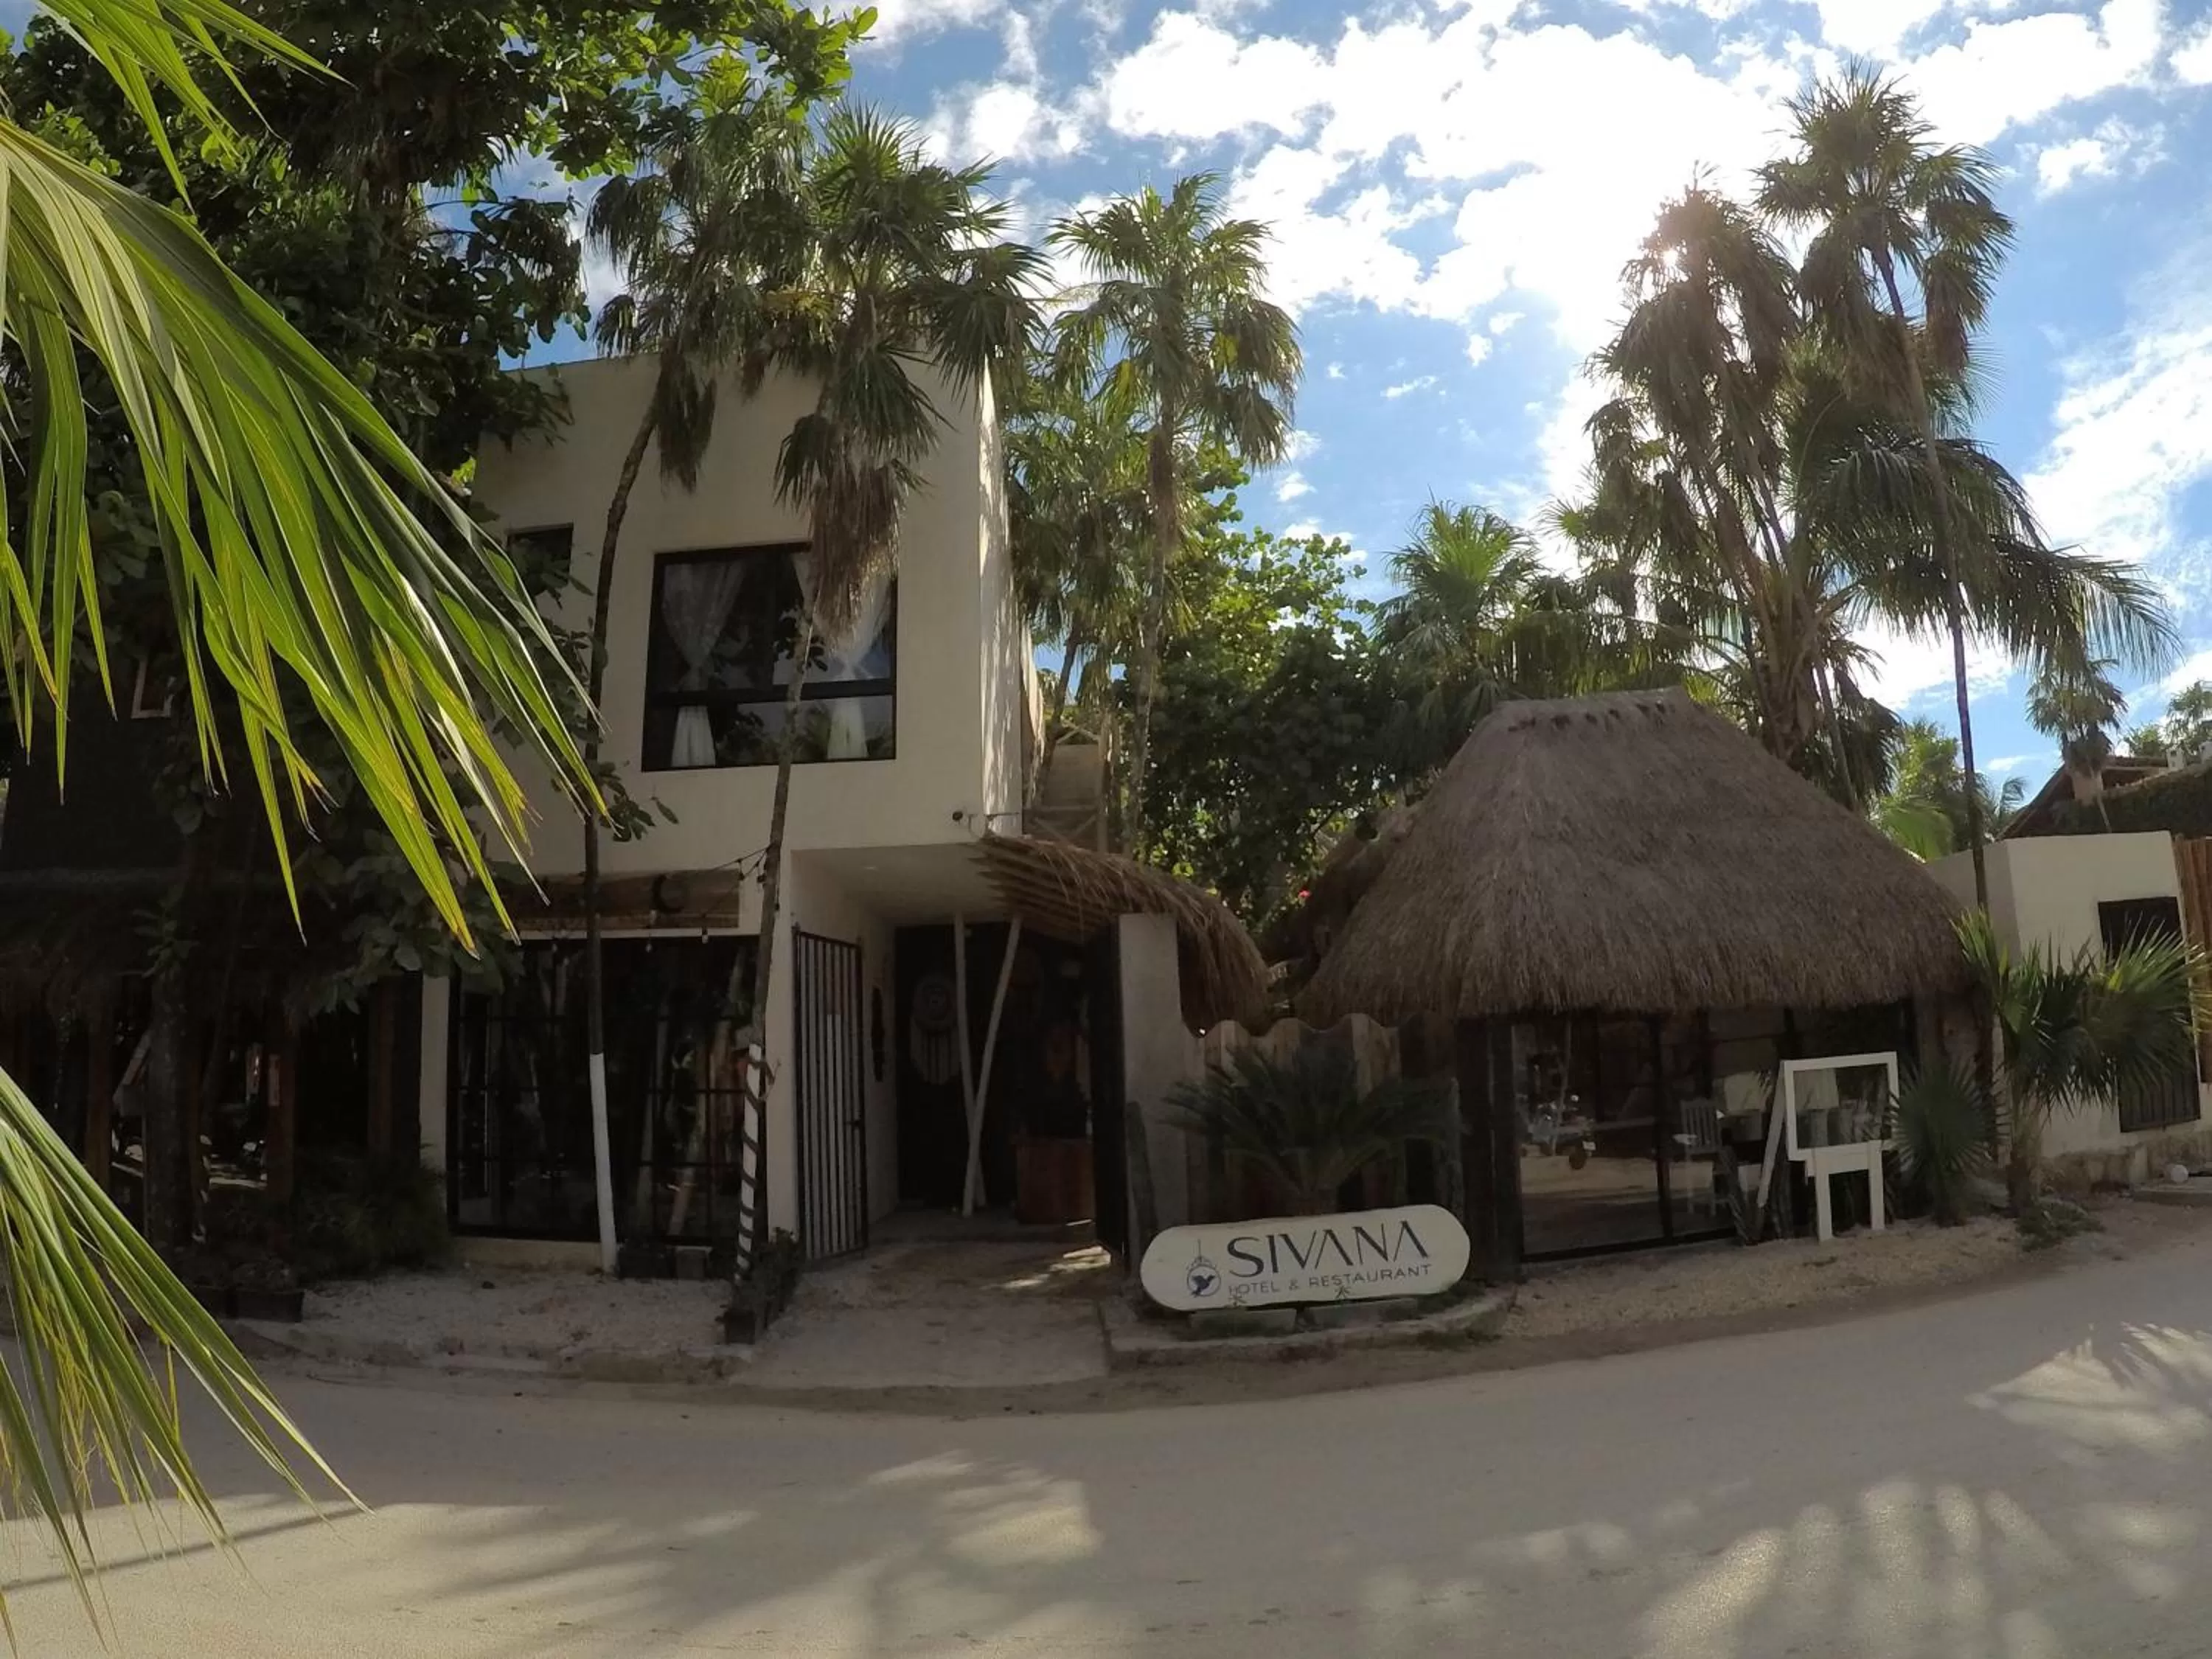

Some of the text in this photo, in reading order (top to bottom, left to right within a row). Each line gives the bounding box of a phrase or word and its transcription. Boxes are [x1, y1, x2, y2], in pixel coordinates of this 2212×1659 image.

[1227, 1220, 1429, 1278] SIVANA
[1228, 1263, 1430, 1295] HOTEL & RESTAURANT
